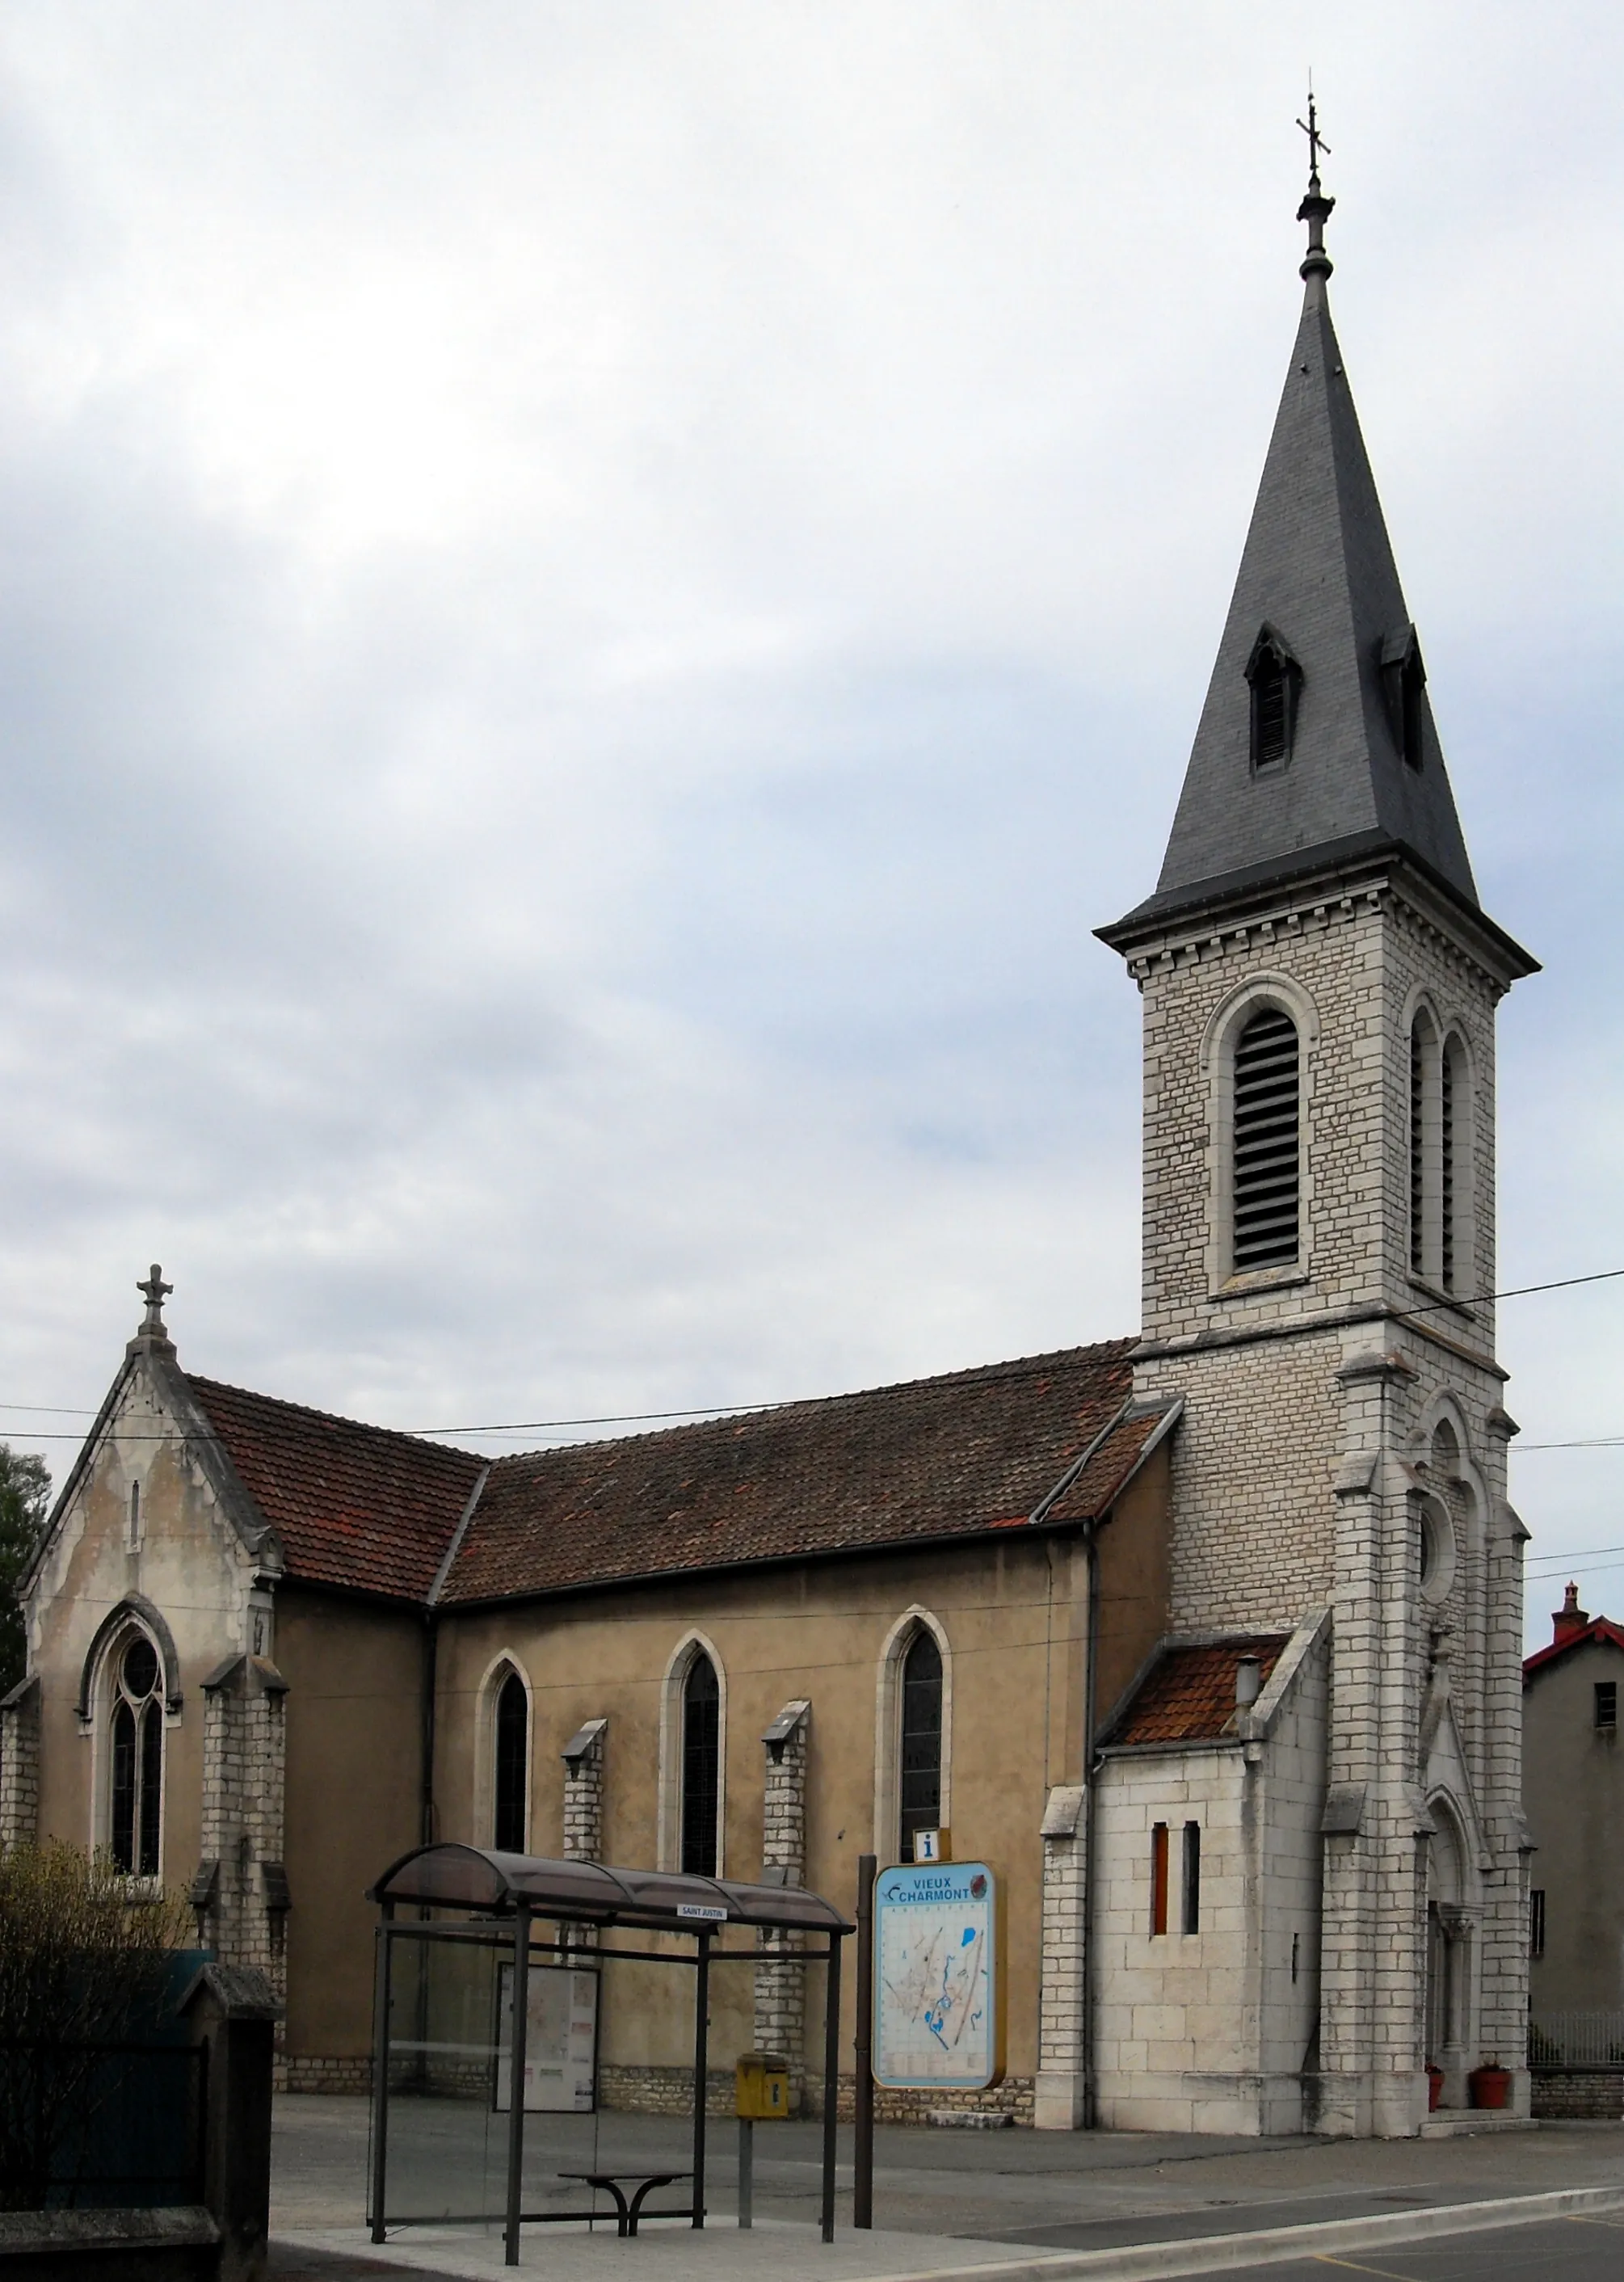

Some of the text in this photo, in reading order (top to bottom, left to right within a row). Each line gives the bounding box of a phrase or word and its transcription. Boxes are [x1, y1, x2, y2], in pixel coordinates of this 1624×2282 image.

[923, 1834, 932, 1857] i
[914, 1877, 951, 1889] VIEUX
[899, 1888, 969, 1901] CHARMONT
[683, 1907, 722, 1918] SAINT JUSTIN
